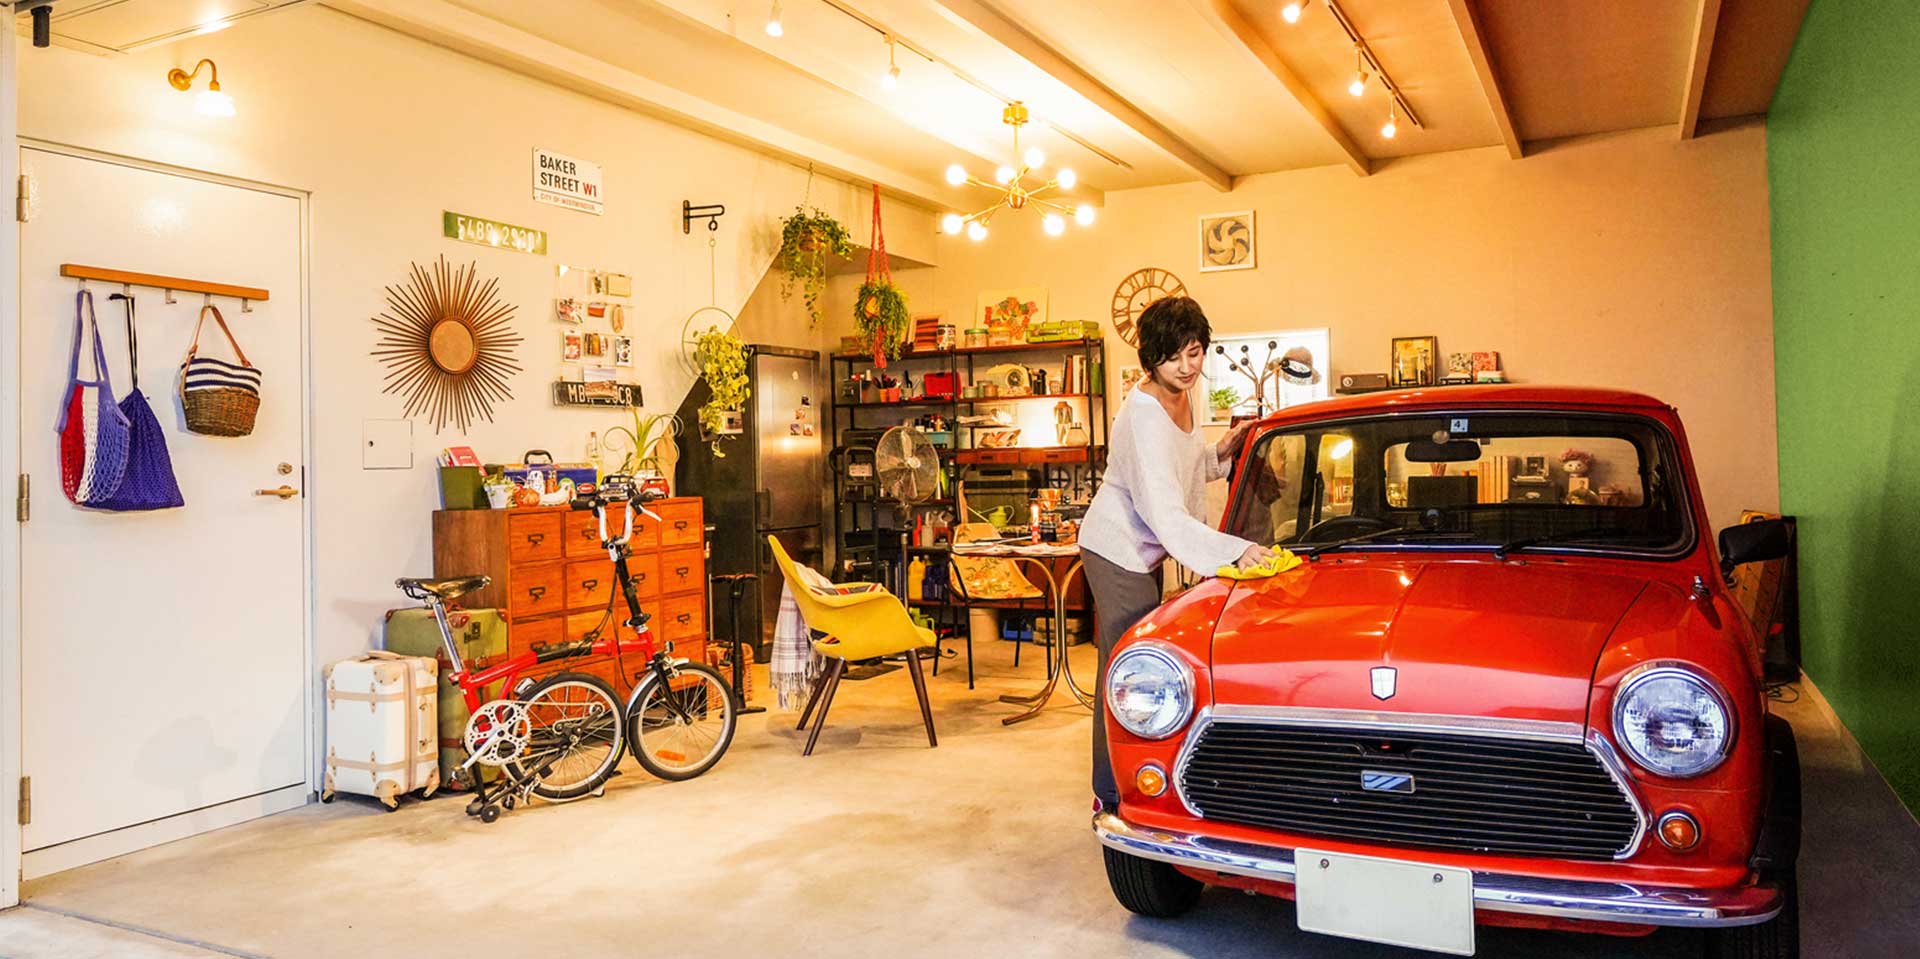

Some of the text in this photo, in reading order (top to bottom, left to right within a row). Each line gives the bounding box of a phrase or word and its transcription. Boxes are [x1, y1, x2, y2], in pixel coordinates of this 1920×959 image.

[540, 154, 576, 175] BAKER
[540, 172, 597, 198] STREET W1
[1453, 420, 1460, 428] 4
